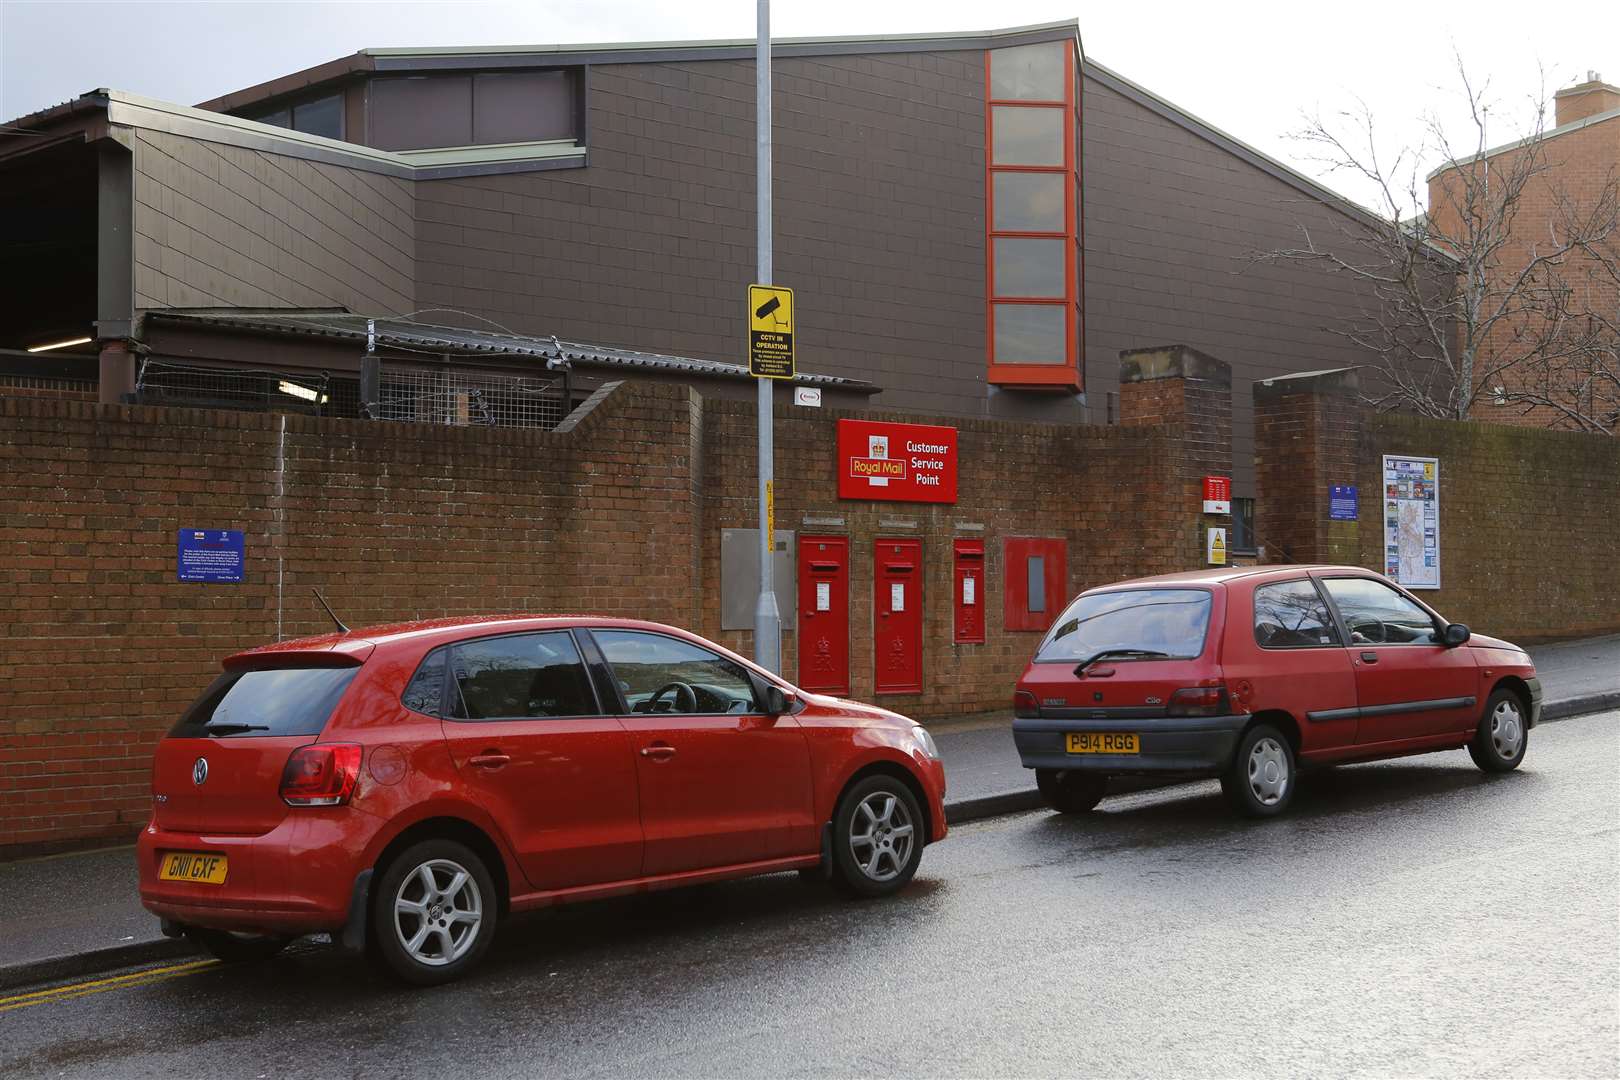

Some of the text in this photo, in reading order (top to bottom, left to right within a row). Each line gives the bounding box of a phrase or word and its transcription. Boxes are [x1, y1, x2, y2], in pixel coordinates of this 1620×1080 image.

[756, 342, 788, 350] OPERATION
[906, 440, 949, 454] Customer
[854, 460, 903, 475] Royal Mail
[911, 457, 944, 470] Service
[916, 473, 940, 486] Point
[1071, 735, 1134, 750] P914 RGG
[168, 855, 220, 879] GN11 GXF
